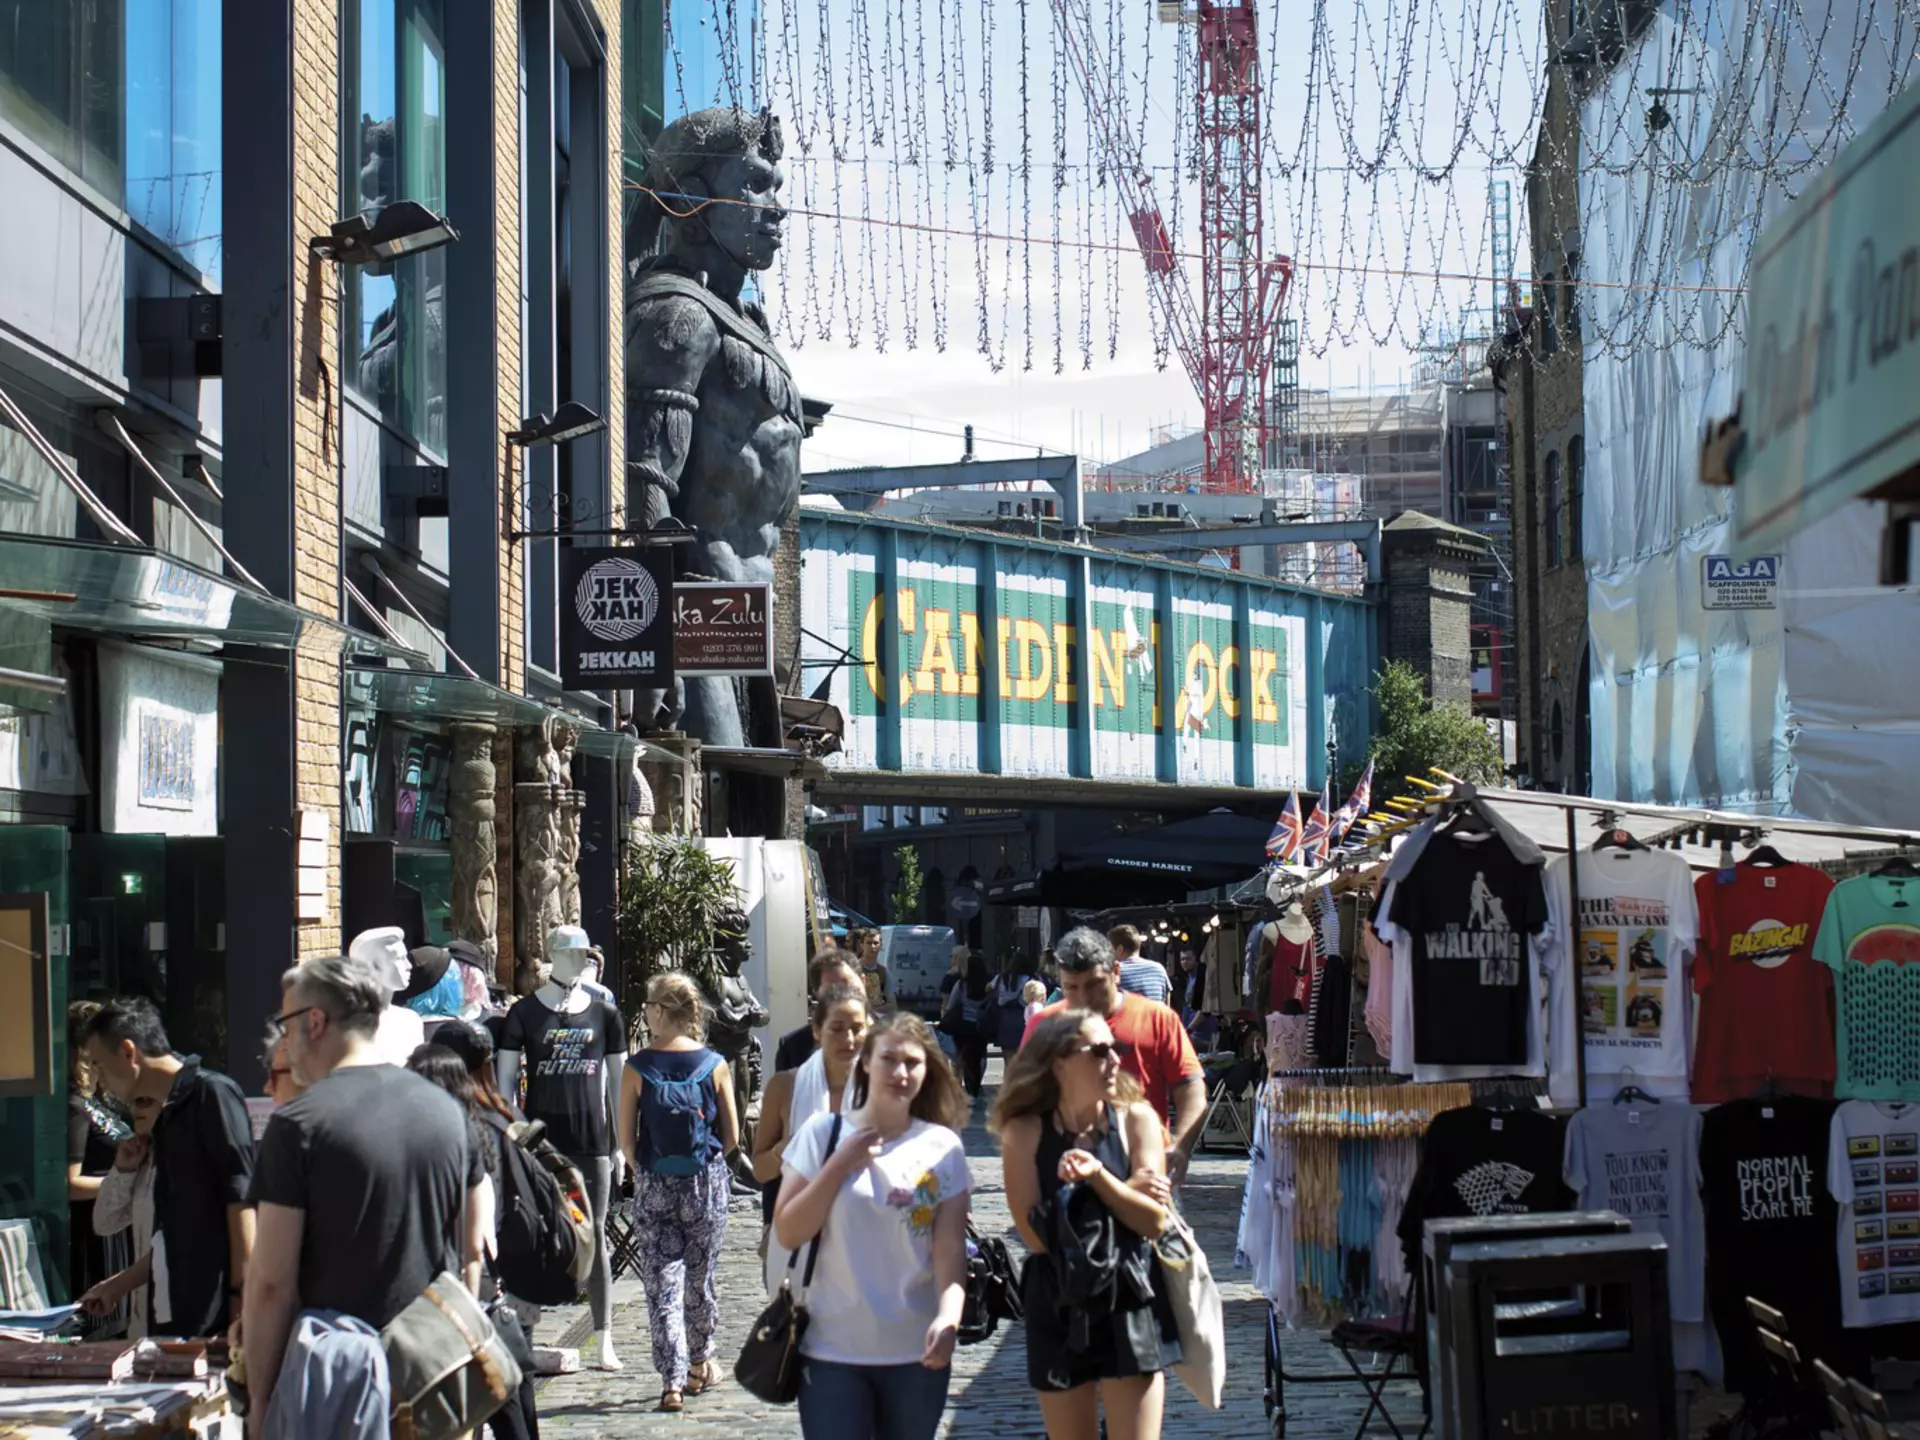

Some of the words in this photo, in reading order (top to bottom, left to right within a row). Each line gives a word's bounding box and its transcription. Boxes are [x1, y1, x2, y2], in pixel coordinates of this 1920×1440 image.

[1712, 560, 1772, 577] AGA
[593, 578, 641, 599] JEK
[712, 593, 765, 625] Zulu
[703, 644, 724, 653] 0203
[579, 651, 655, 669] JEKKAH
[1107, 858, 1149, 868] CAMDEN
[1152, 862, 1193, 872] MARKET
[1580, 898, 1613, 913] THE
[1579, 915, 1629, 926] ANANA
[1424, 931, 1520, 959] WALKING
[1729, 923, 1808, 957] BAZINGA!
[543, 1028, 594, 1044] FROM
[552, 1044, 584, 1059] THE
[536, 1059, 598, 1076] FUTURE
[1604, 1157, 1629, 1176] YOU
[1632, 1154, 1669, 1173] KNOW
[1737, 1155, 1813, 1179] NORMAL
[1609, 1174, 1665, 1195] NOTHING
[1740, 1175, 1813, 1204] PEOPLE
[1635, 1194, 1669, 1213] SNOW
[1742, 1202, 1789, 1220] SCARE
[1793, 1200, 1813, 1216] ME
[1511, 1402, 1632, 1435] LITTER
